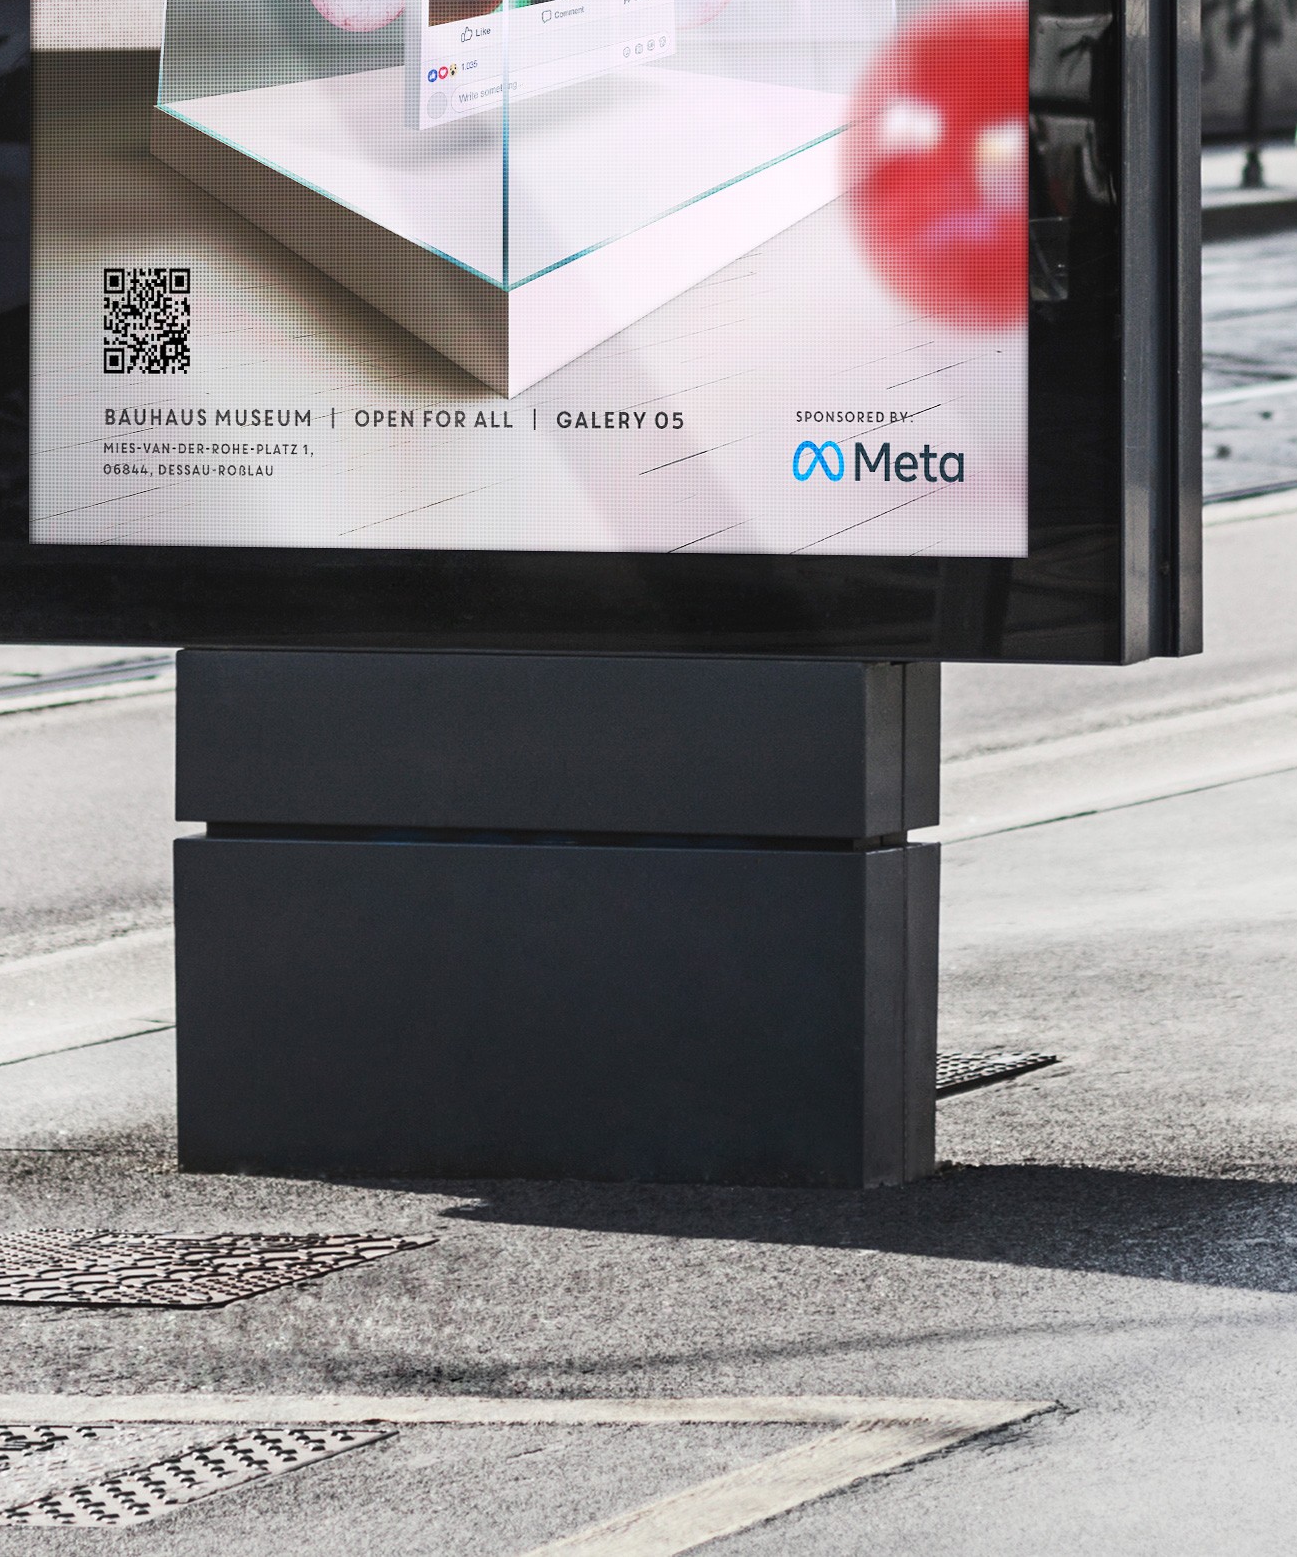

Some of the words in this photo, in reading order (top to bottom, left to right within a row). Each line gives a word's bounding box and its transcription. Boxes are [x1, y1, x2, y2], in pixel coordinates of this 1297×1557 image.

[475, 27, 491, 37] Like
[554, 5, 585, 19] Comment
[459, 91, 479, 103] Write
[104, 408, 208, 426] BAUHAUS
[215, 408, 312, 428] MUSEUM
[354, 410, 415, 428] OPEN
[423, 411, 467, 428] FOR
[474, 411, 514, 429] ALL
[556, 411, 646, 430] GALERY
[655, 411, 685, 430] 05
[796, 410, 885, 423] SPONSORED
[103, 442, 298, 455] MIES-VAN-DER-ROHE-PLATZ
[302, 444, 314, 457] 1,
[854, 442, 965, 482] Meta
